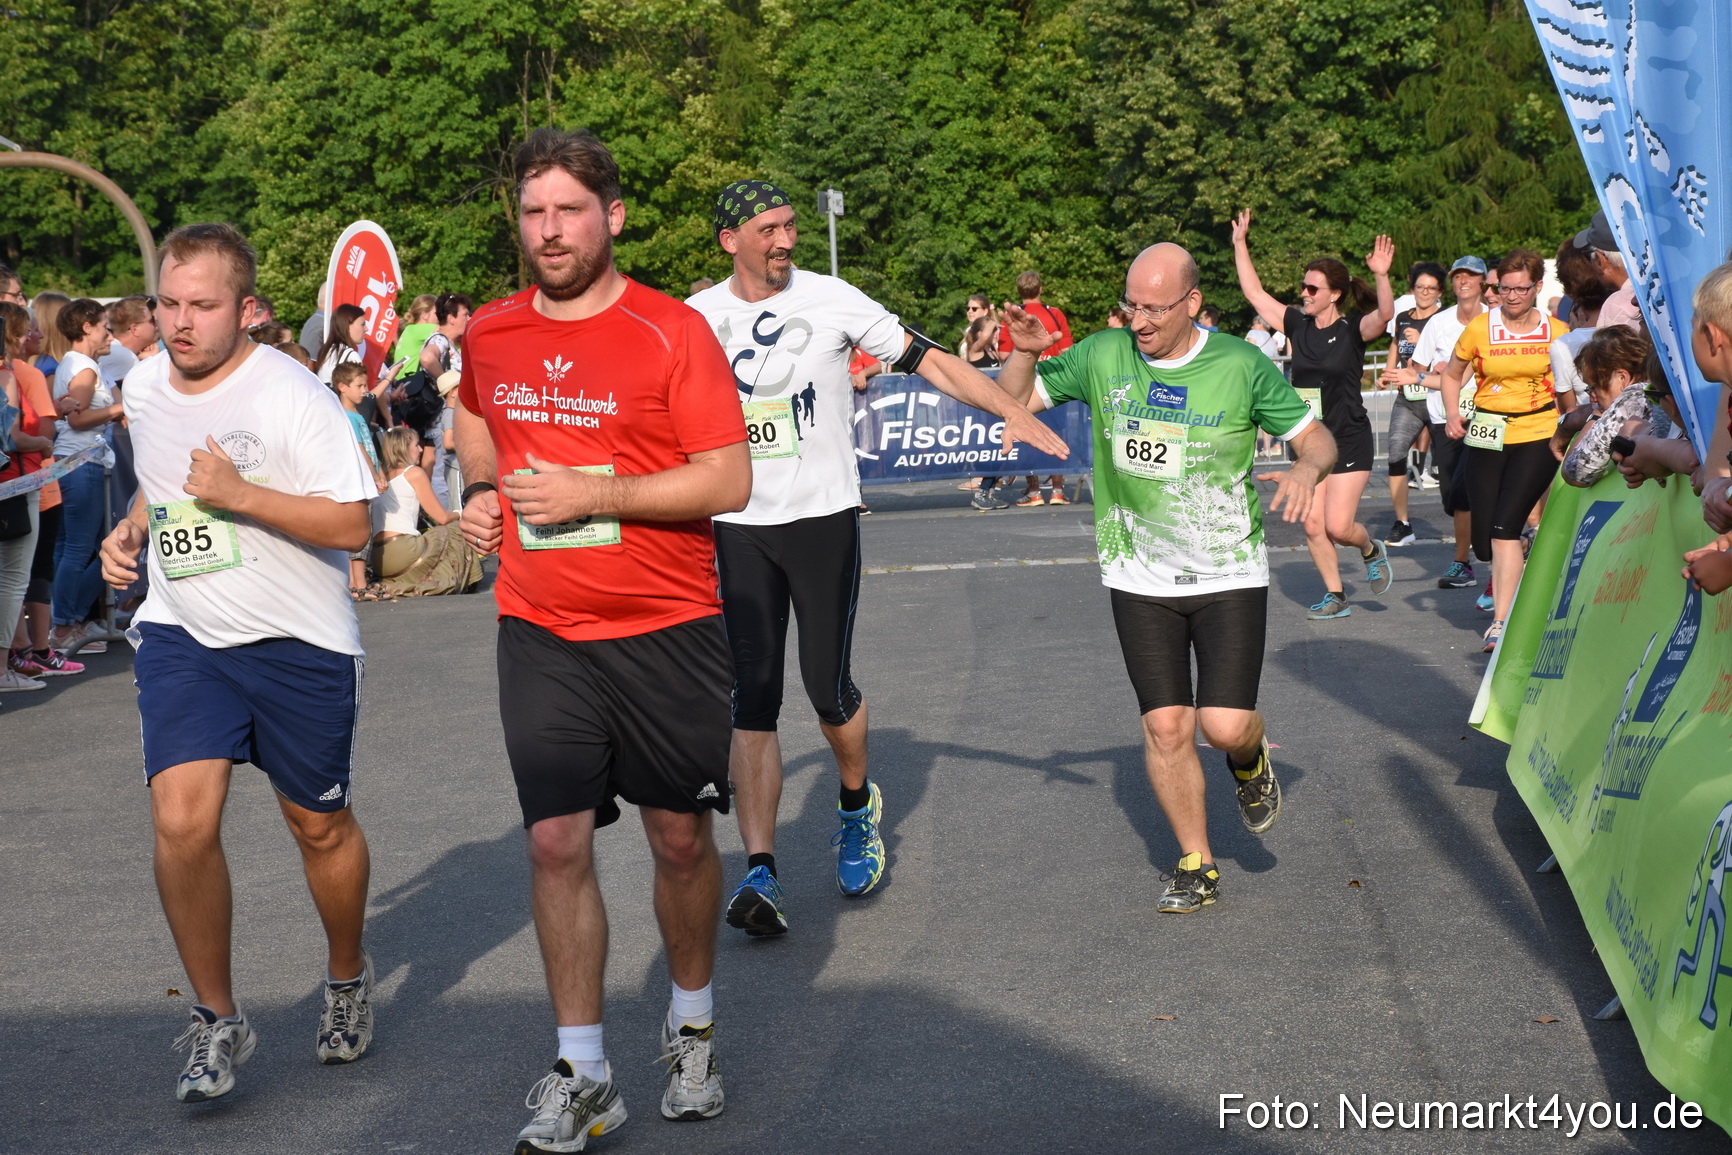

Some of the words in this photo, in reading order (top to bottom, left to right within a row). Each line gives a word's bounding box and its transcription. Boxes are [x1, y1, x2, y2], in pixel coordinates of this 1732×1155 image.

[346, 245, 360, 274] AVIA
[1489, 348, 1516, 357] MAX
[1521, 345, 1549, 355] BÖGL
[493, 383, 541, 407] Echtes
[541, 386, 618, 416] Handwerk
[1156, 392, 1184, 402] Fischer
[507, 409, 549, 423] IMMER
[554, 413, 600, 428] FRISCH
[1126, 399, 1226, 427] firmenlauf
[747, 422, 776, 444] 80
[880, 416, 1008, 451] Fische
[1470, 424, 1497, 440] 684
[1126, 438, 1167, 465] 682
[1128, 460, 1148, 468] Roland
[535, 527, 554, 535] Feihl
[555, 526, 596, 535] Johannes
[159, 525, 212, 557] 685
[192, 552, 218, 561] Bartek
